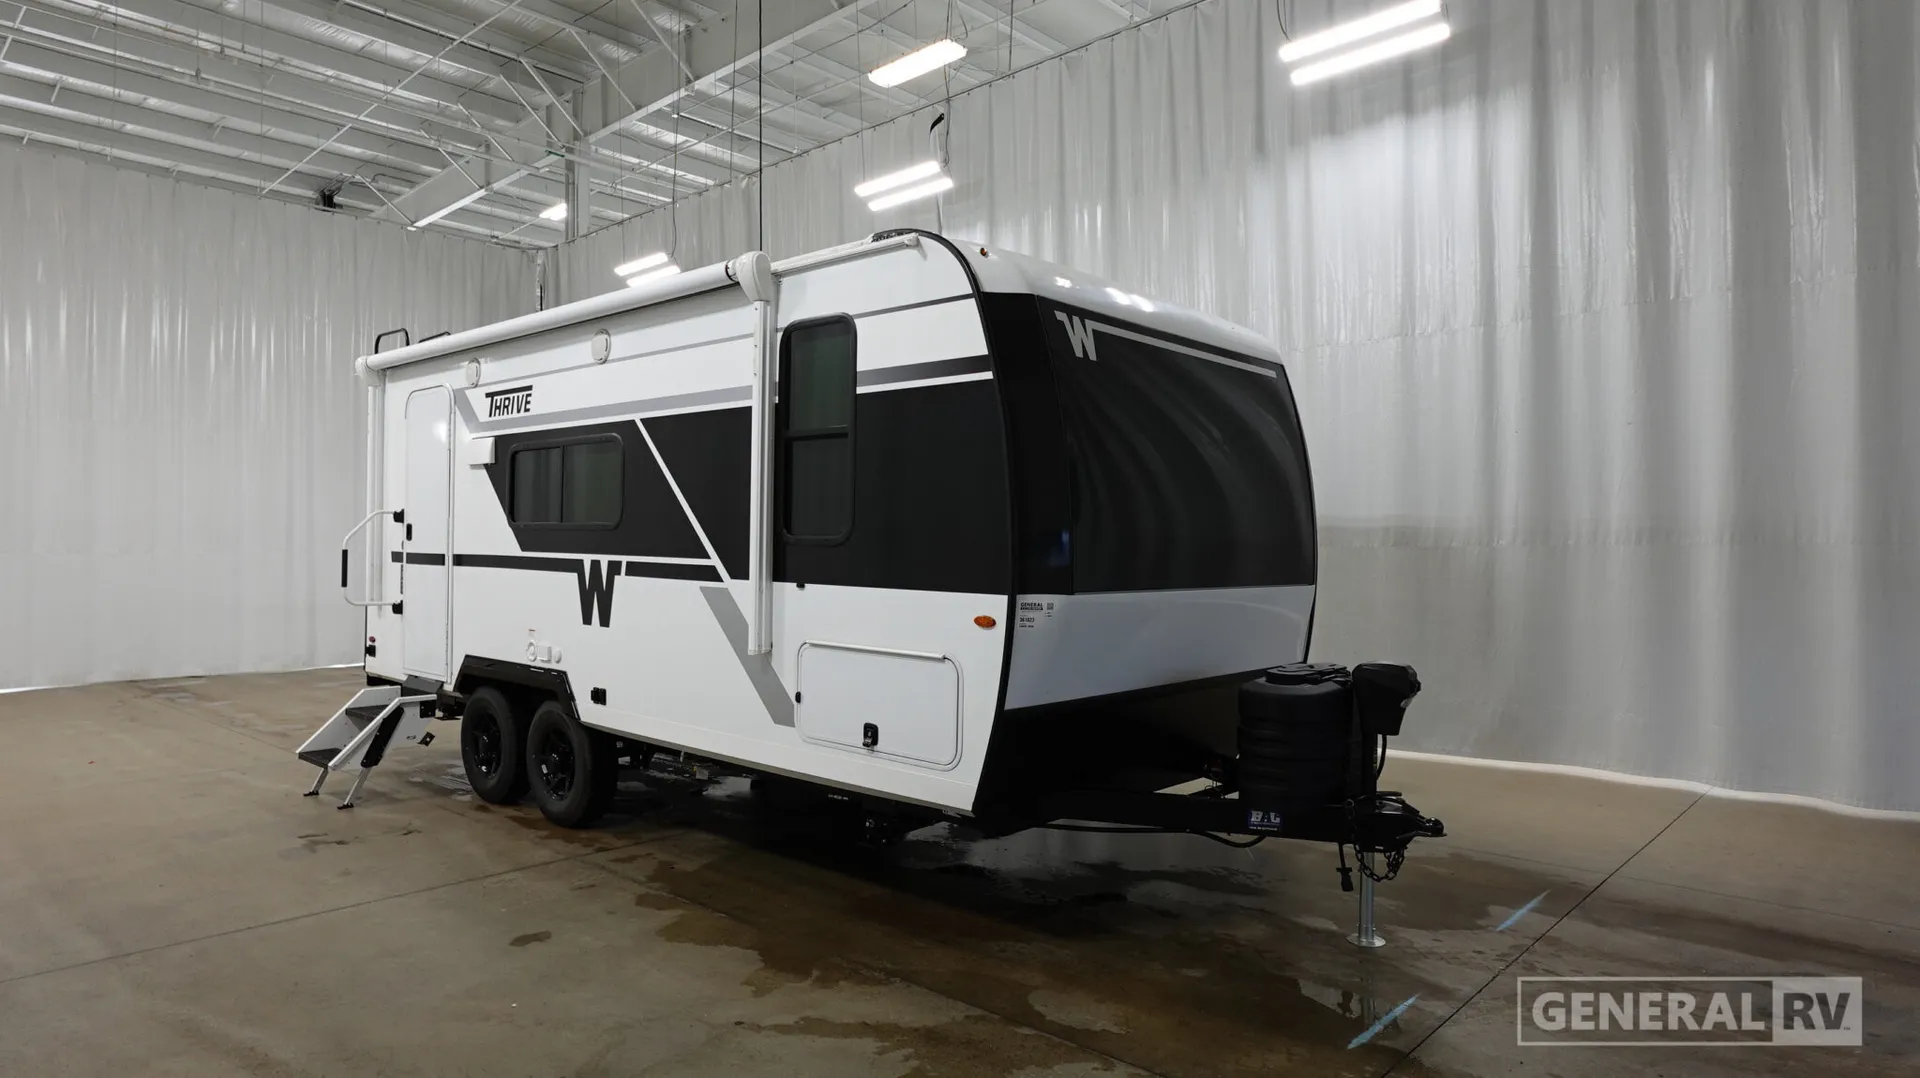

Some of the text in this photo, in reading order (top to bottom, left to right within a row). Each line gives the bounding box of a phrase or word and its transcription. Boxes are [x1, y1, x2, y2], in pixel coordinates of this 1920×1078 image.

[1054, 309, 1098, 361] W
[485, 384, 533, 418] THRIVE
[577, 558, 623, 628] W
